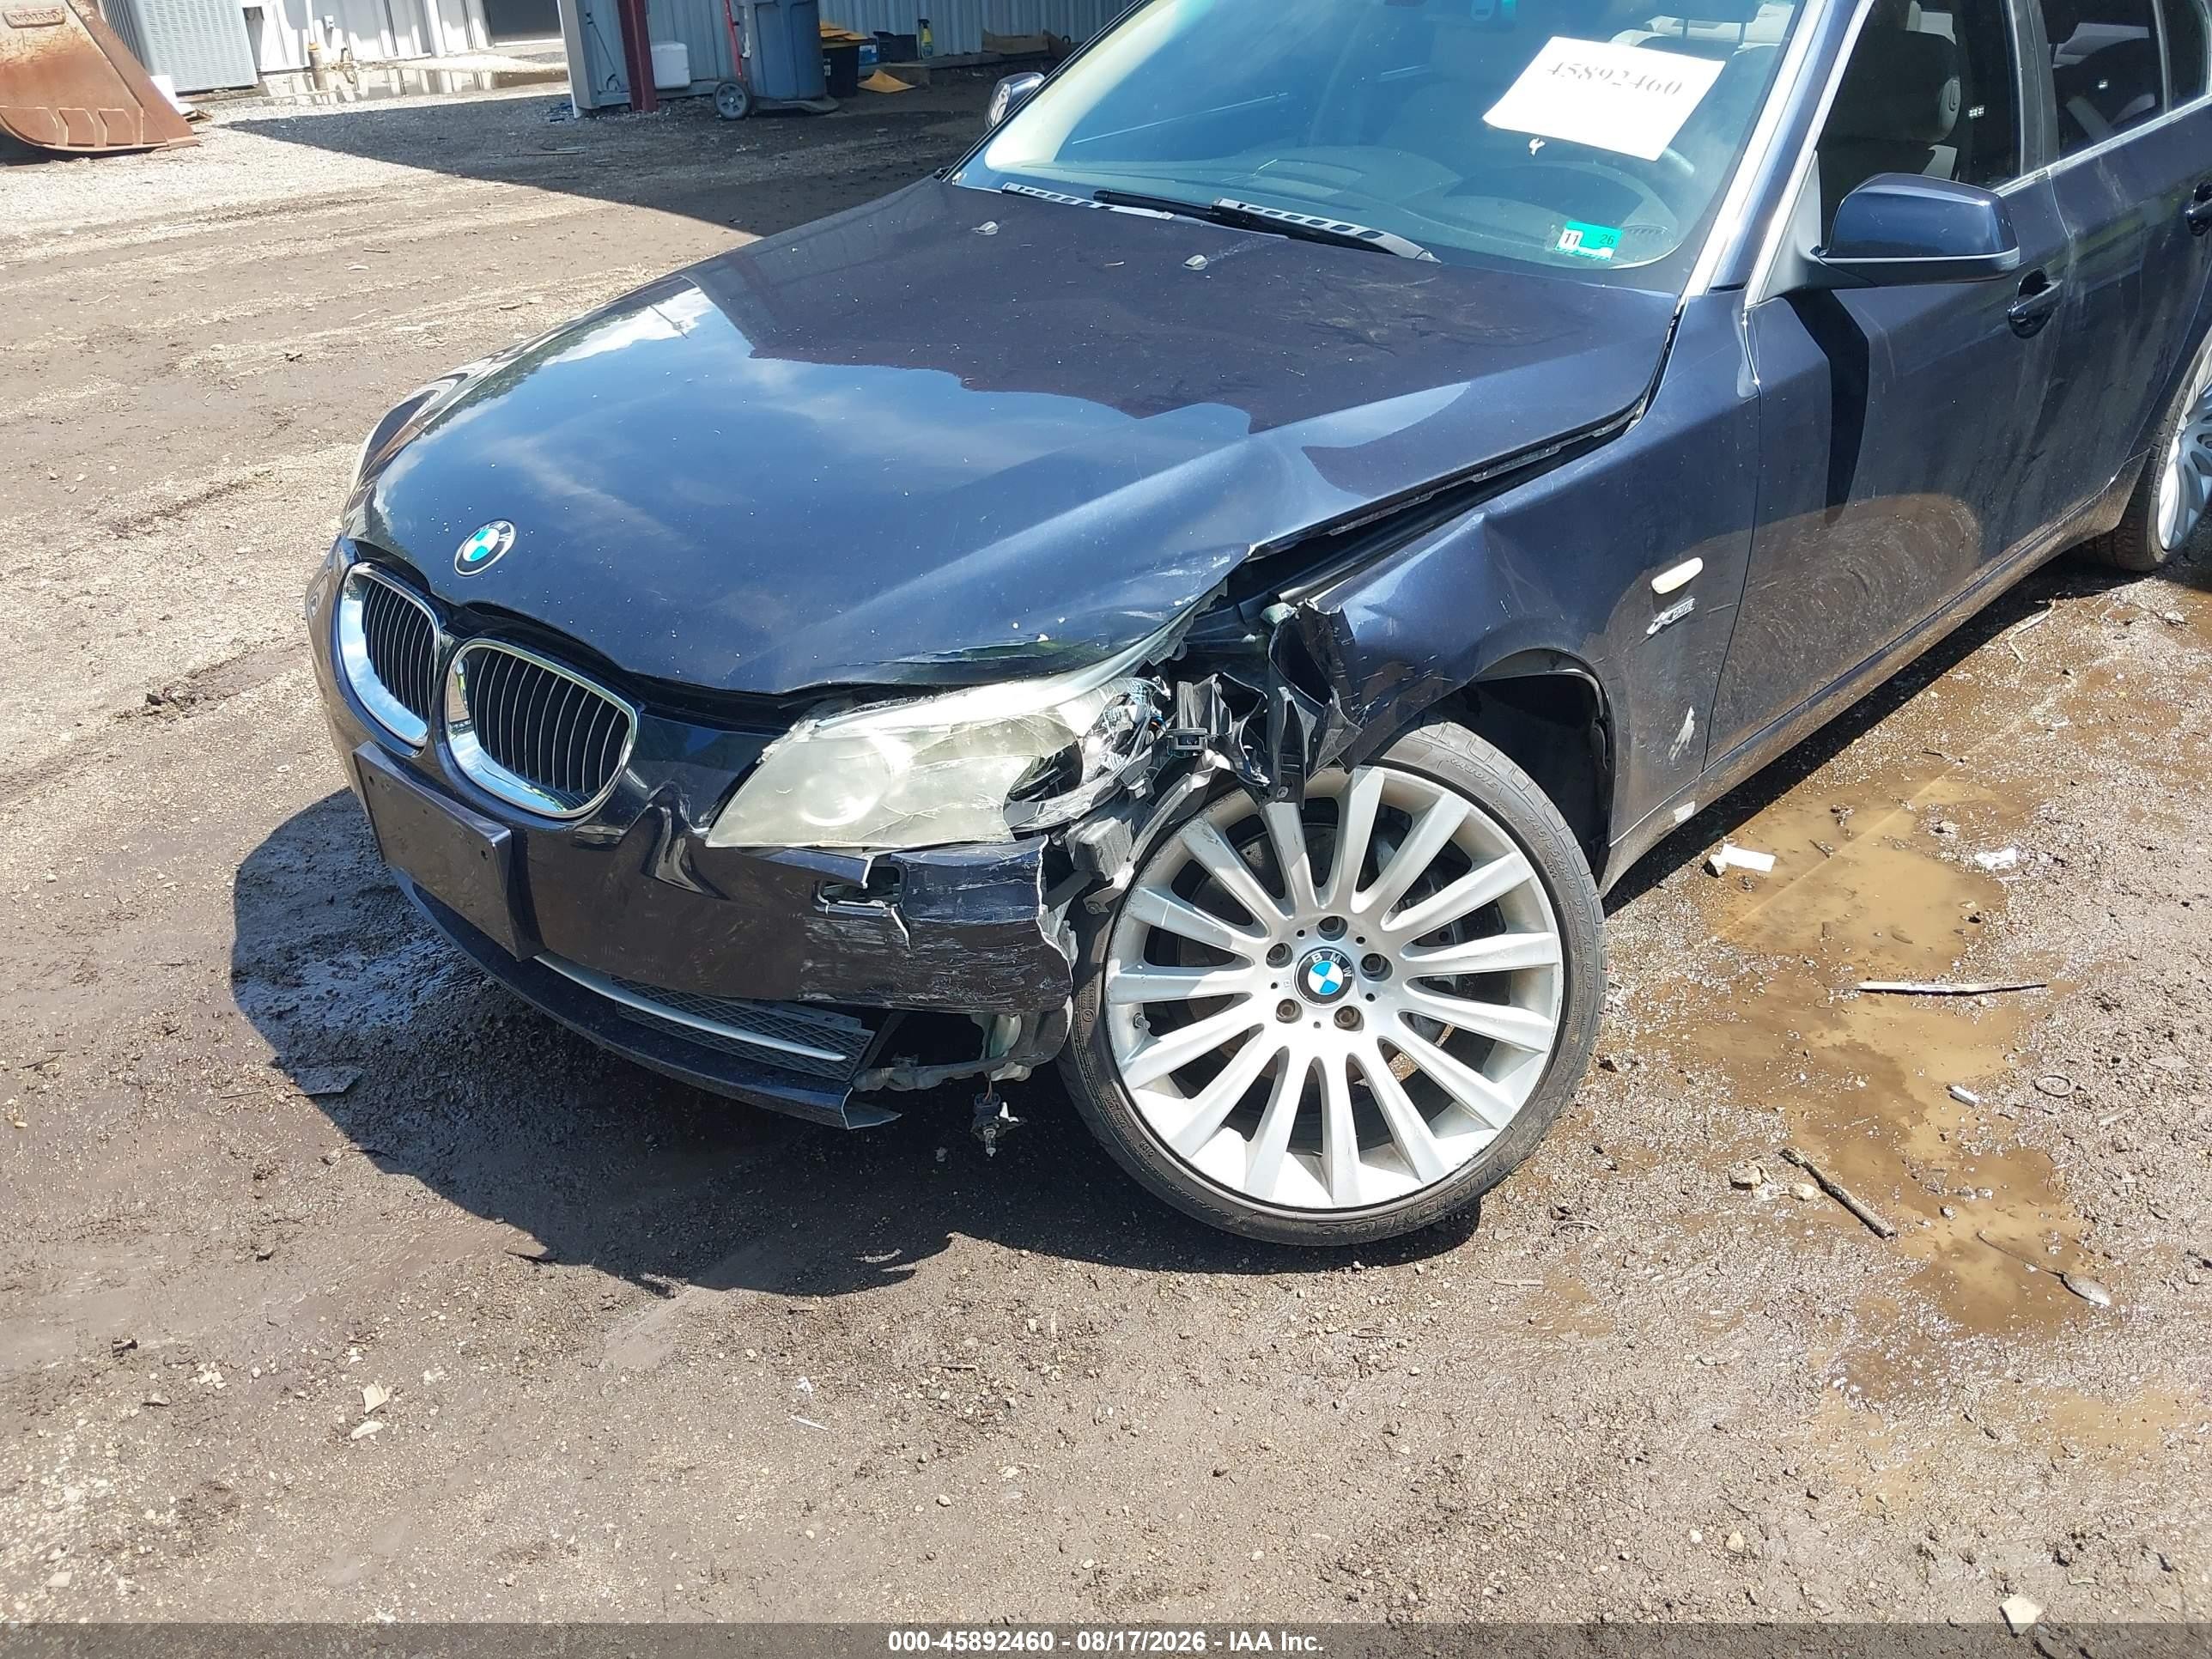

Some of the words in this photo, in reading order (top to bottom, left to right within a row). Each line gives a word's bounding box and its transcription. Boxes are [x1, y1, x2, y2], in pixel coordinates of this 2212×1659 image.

[1547, 61, 1683, 96] 45892460
[1564, 233, 1580, 246] 11
[1599, 234, 1615, 246] 26
[1311, 952, 1352, 977] BMW
